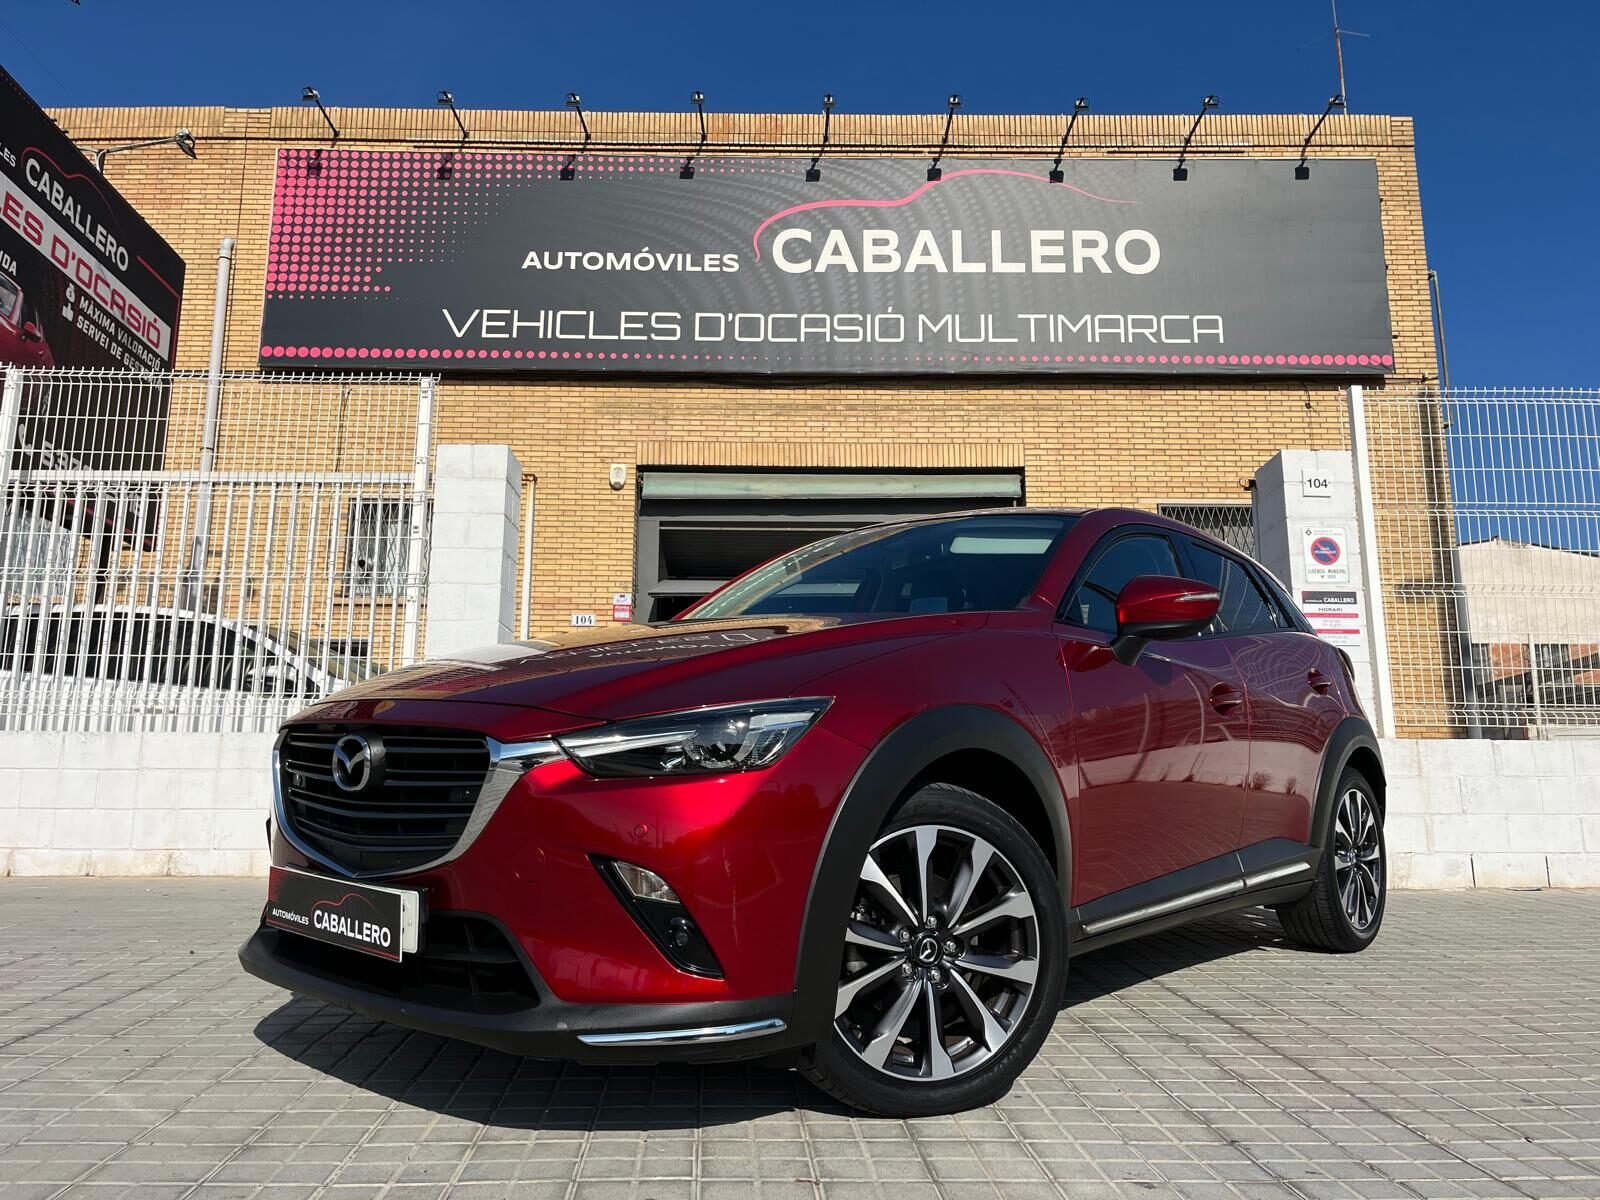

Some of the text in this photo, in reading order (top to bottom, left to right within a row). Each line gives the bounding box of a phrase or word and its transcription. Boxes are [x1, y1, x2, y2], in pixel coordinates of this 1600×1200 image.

[26, 158, 129, 271] CABALLERO
[0, 250, 17, 277] DA
[0, 191, 161, 350] ES D'OCASIÓ
[521, 229, 1161, 275] AUTOMÓVILES CABALLERO
[76, 314, 110, 350] SERVEI
[110, 341, 123, 361] DE
[442, 306, 1225, 344] VEHICLES D'OCASIÓ MULTIMARCA
[116, 327, 161, 372] VALORACIÓ
[1306, 478, 1329, 489] 104
[575, 615, 593, 625] 104
[272, 907, 392, 948] AUTOMÓVILES CABALLERO
